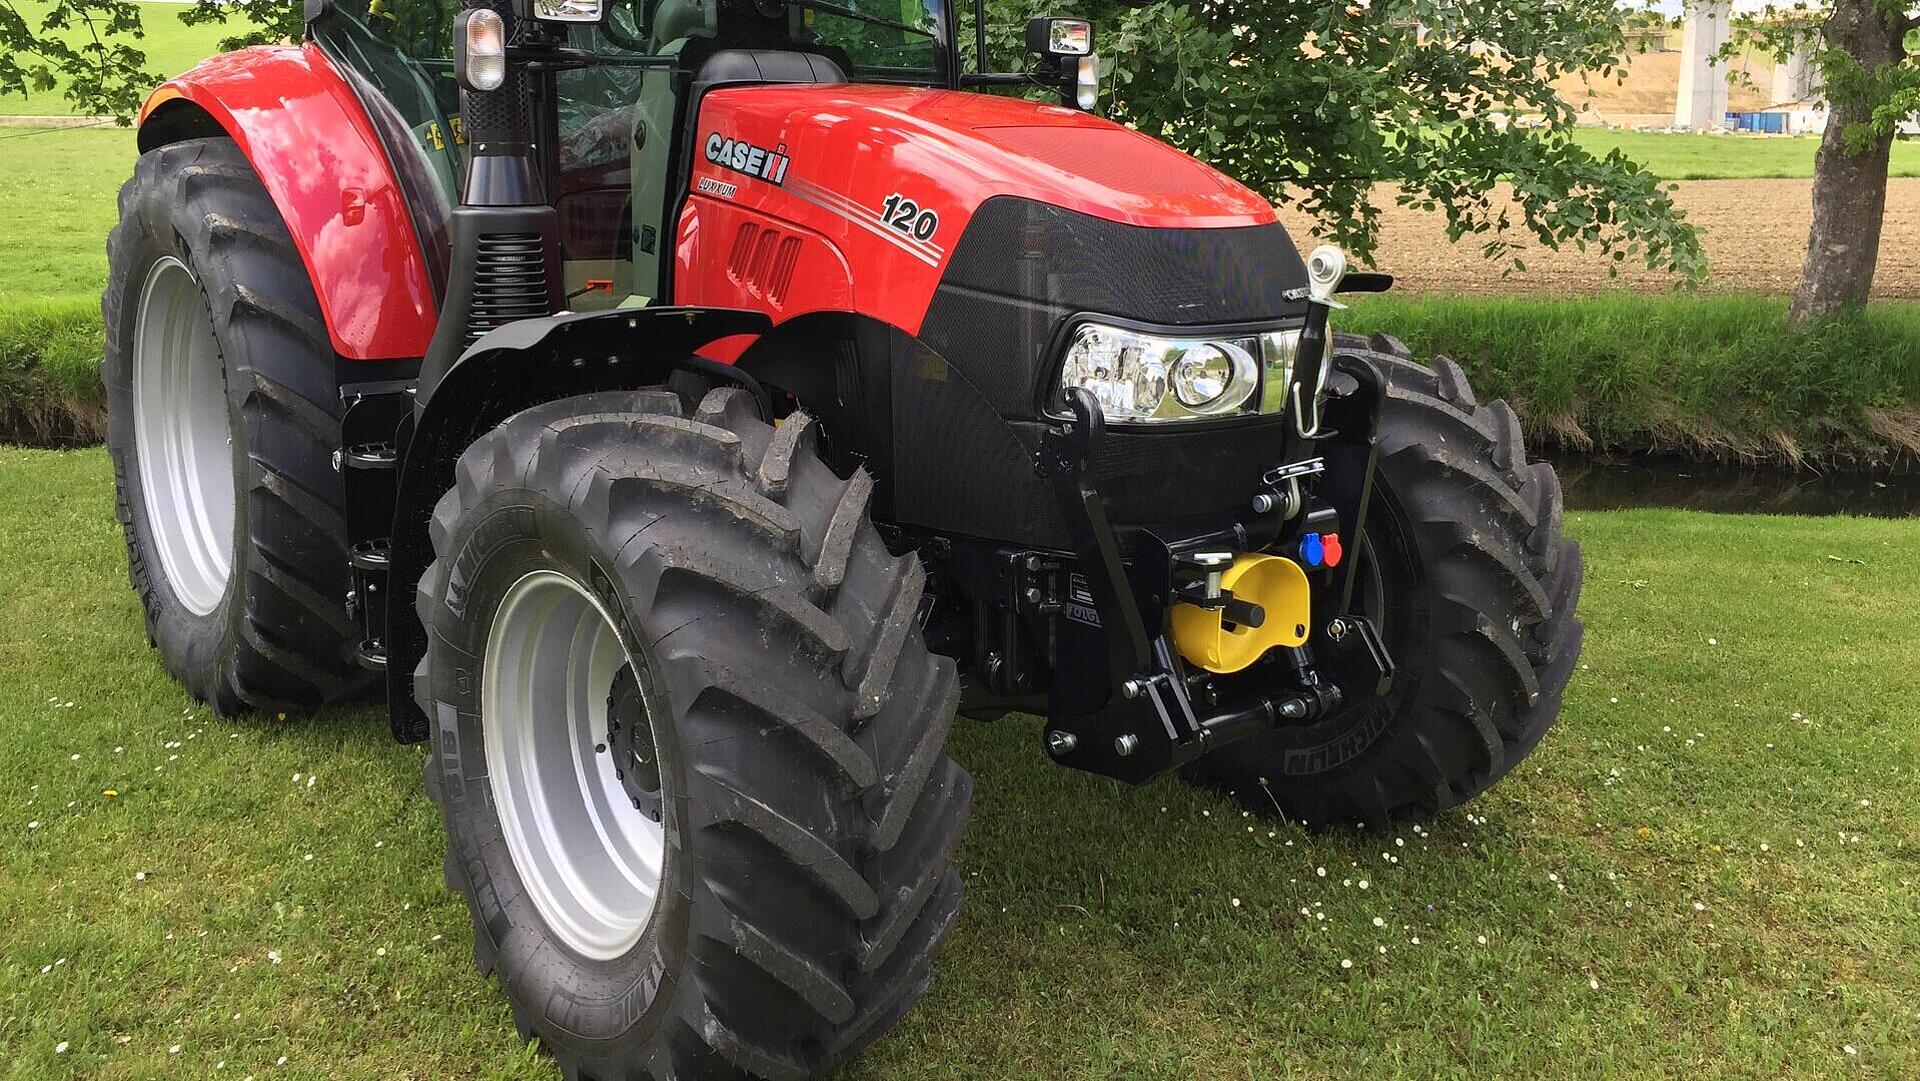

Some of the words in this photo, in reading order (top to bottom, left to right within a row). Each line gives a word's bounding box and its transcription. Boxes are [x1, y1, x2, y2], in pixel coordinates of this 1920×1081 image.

[698, 178, 736, 198] LUXXUM
[882, 194, 938, 241] 120
[1287, 699, 1393, 774] MICHELIN
